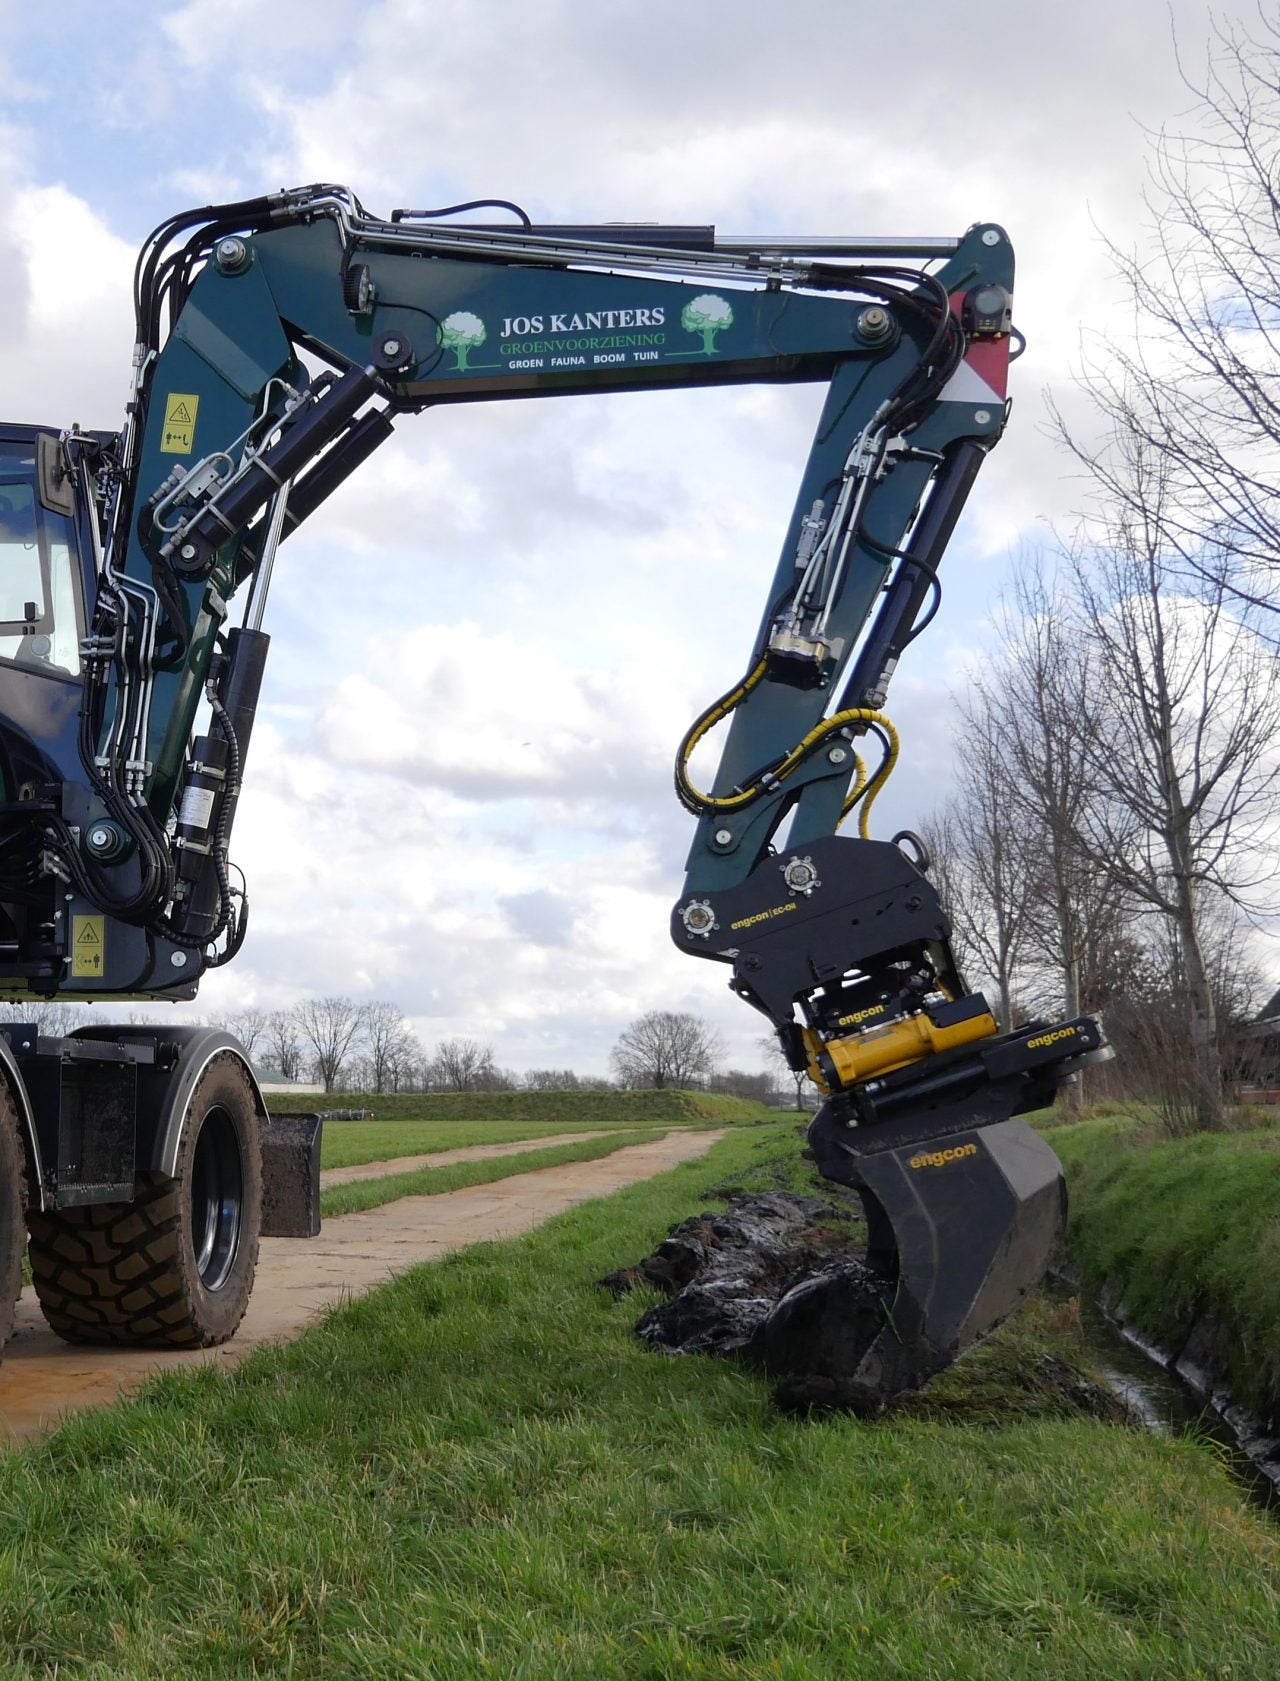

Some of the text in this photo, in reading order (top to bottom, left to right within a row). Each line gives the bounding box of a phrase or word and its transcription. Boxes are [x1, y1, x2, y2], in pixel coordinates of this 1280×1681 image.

[500, 307, 665, 338] JOS KANTERS
[500, 333, 665, 355] GROENVOORZIENING
[508, 351, 659, 369] GROEN FAUNA BOOM TUIN
[731, 911, 769, 930] engcon
[838, 1004, 885, 1025] engcon
[1027, 1026, 1076, 1048] engcon
[910, 1143, 977, 1169] engcon
